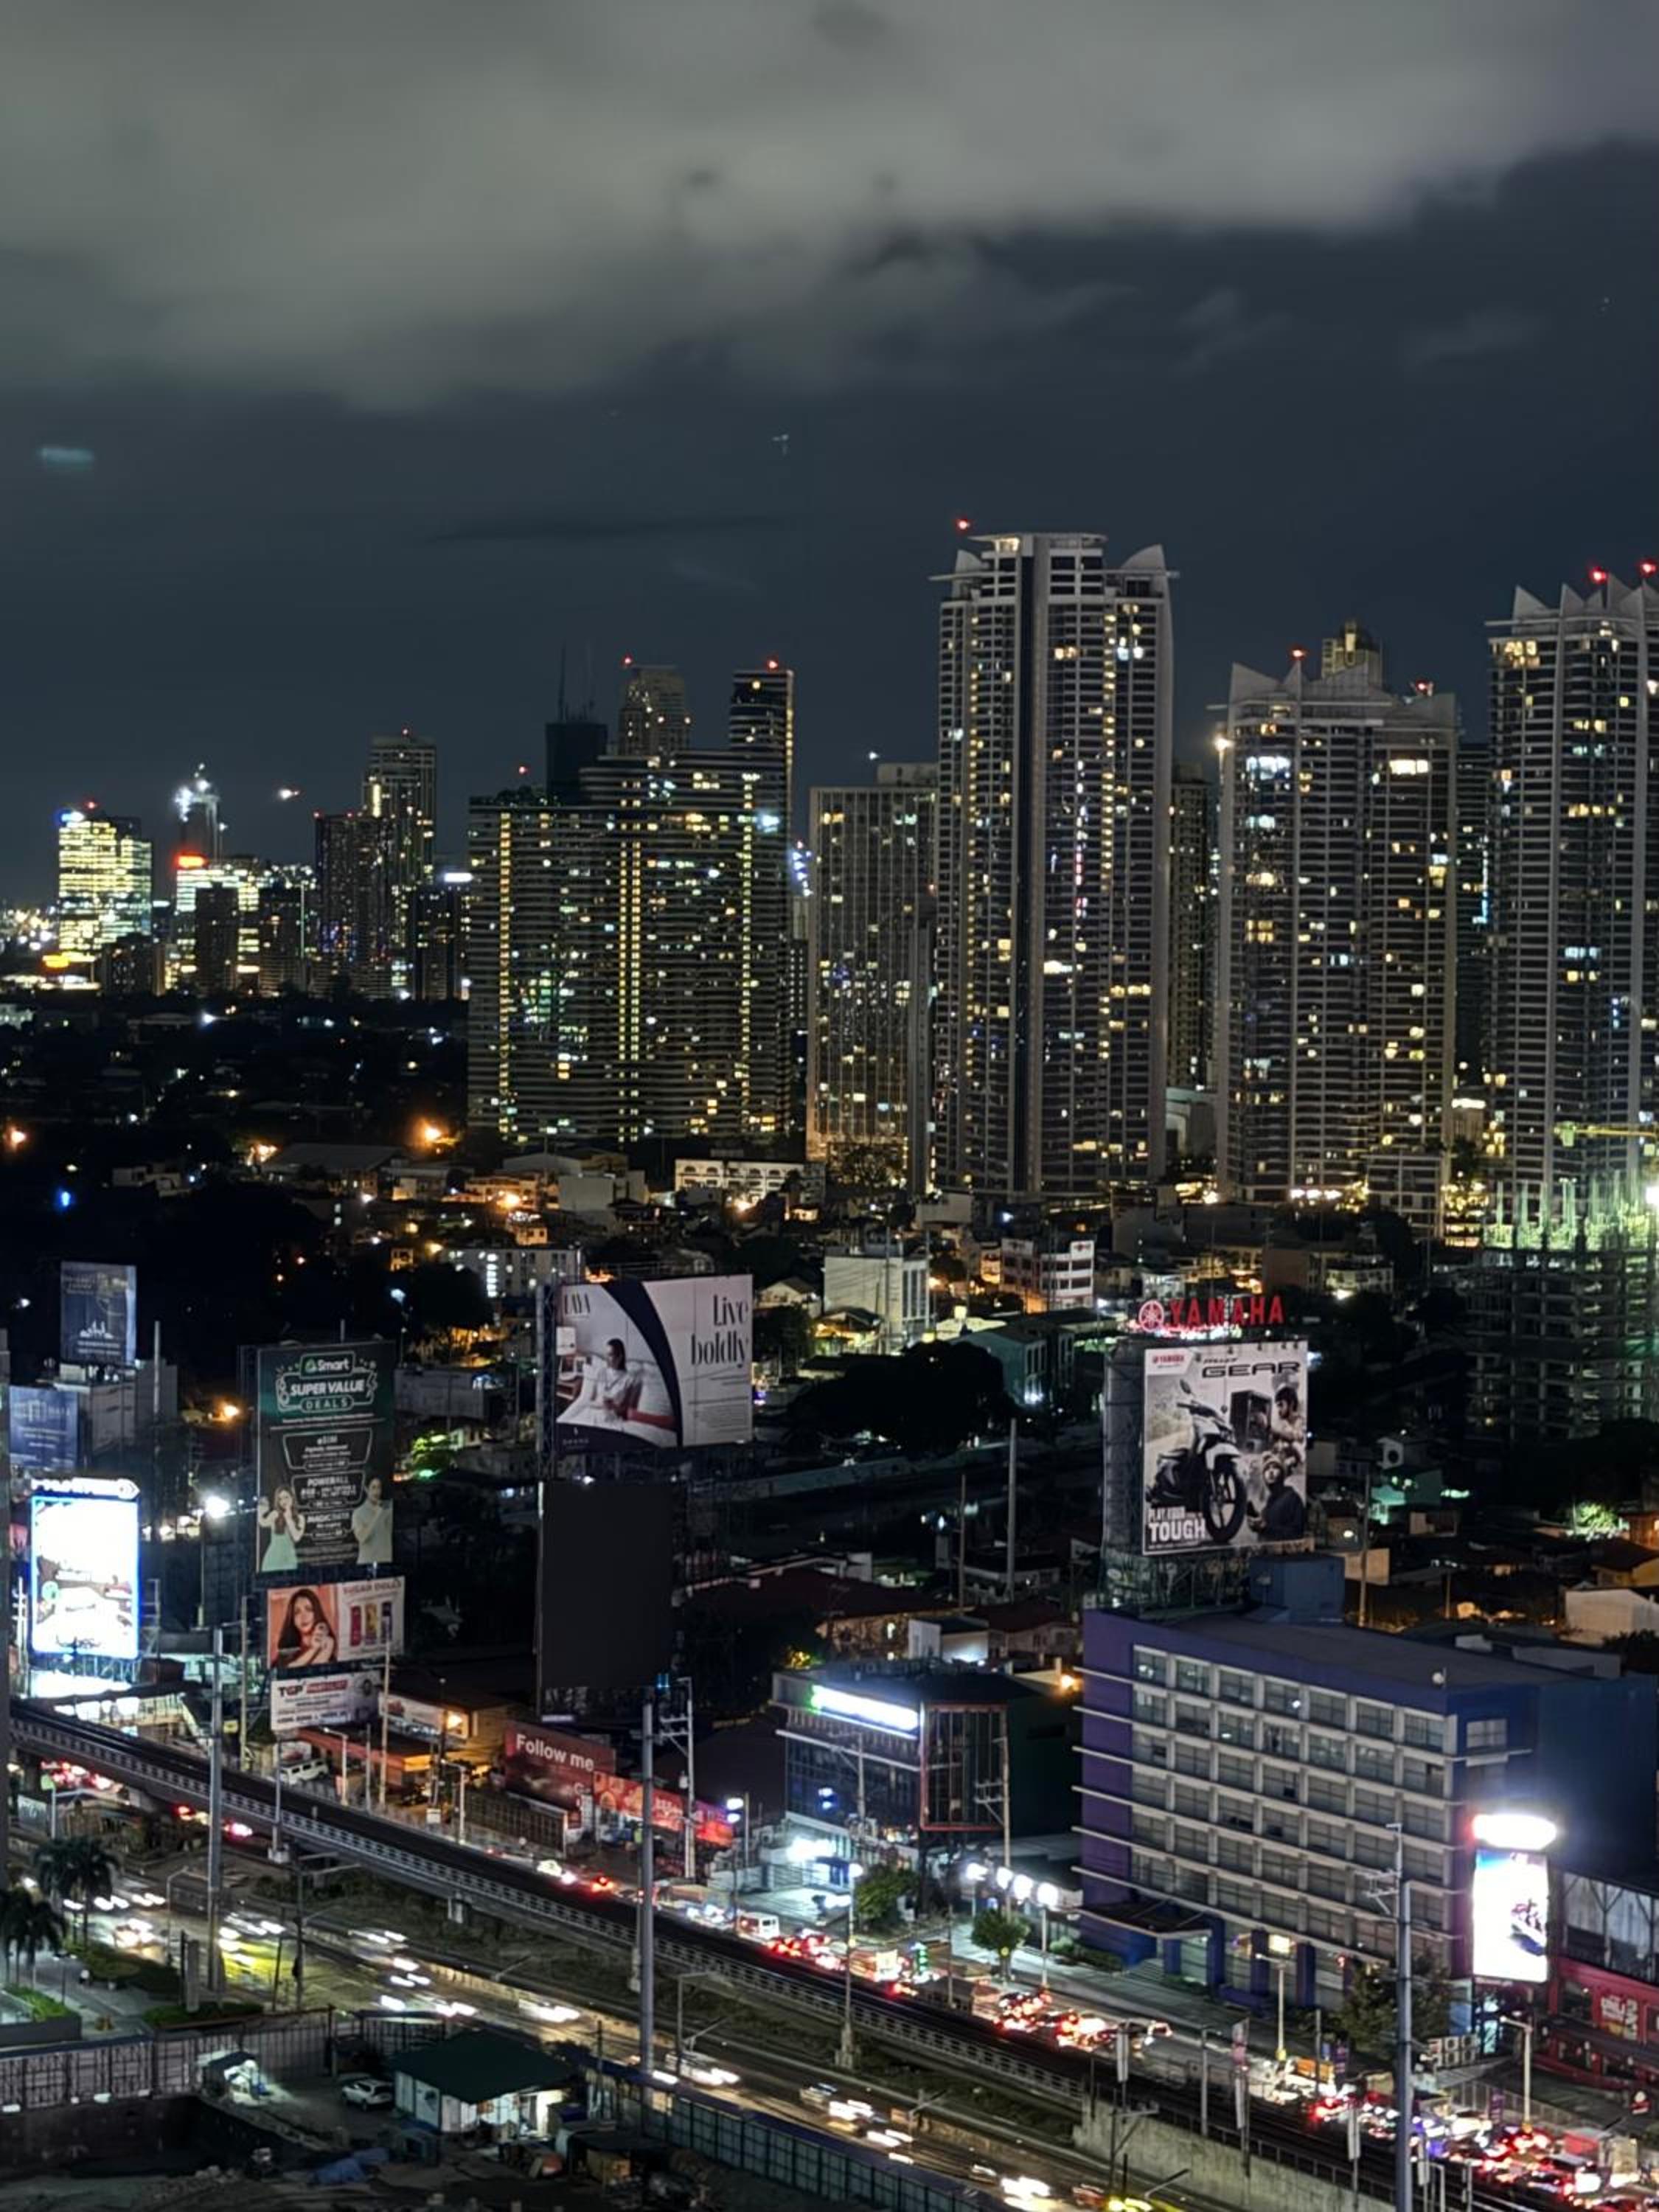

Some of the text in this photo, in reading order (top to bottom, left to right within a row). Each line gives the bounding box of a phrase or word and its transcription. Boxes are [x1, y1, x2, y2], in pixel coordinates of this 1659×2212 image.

[714, 1294, 749, 1326] Live
[1169, 1296, 1284, 1326] YAMAHA
[691, 1330, 749, 1368] boldly
[318, 1358, 349, 1372] Smart
[1202, 1361, 1300, 1378] GEAR
[290, 1380, 365, 1396] SUPER VALUE
[306, 1398, 348, 1411] DEALS
[1148, 1518, 1206, 1543] TOUGH
[516, 1733, 594, 1772] Follow me
